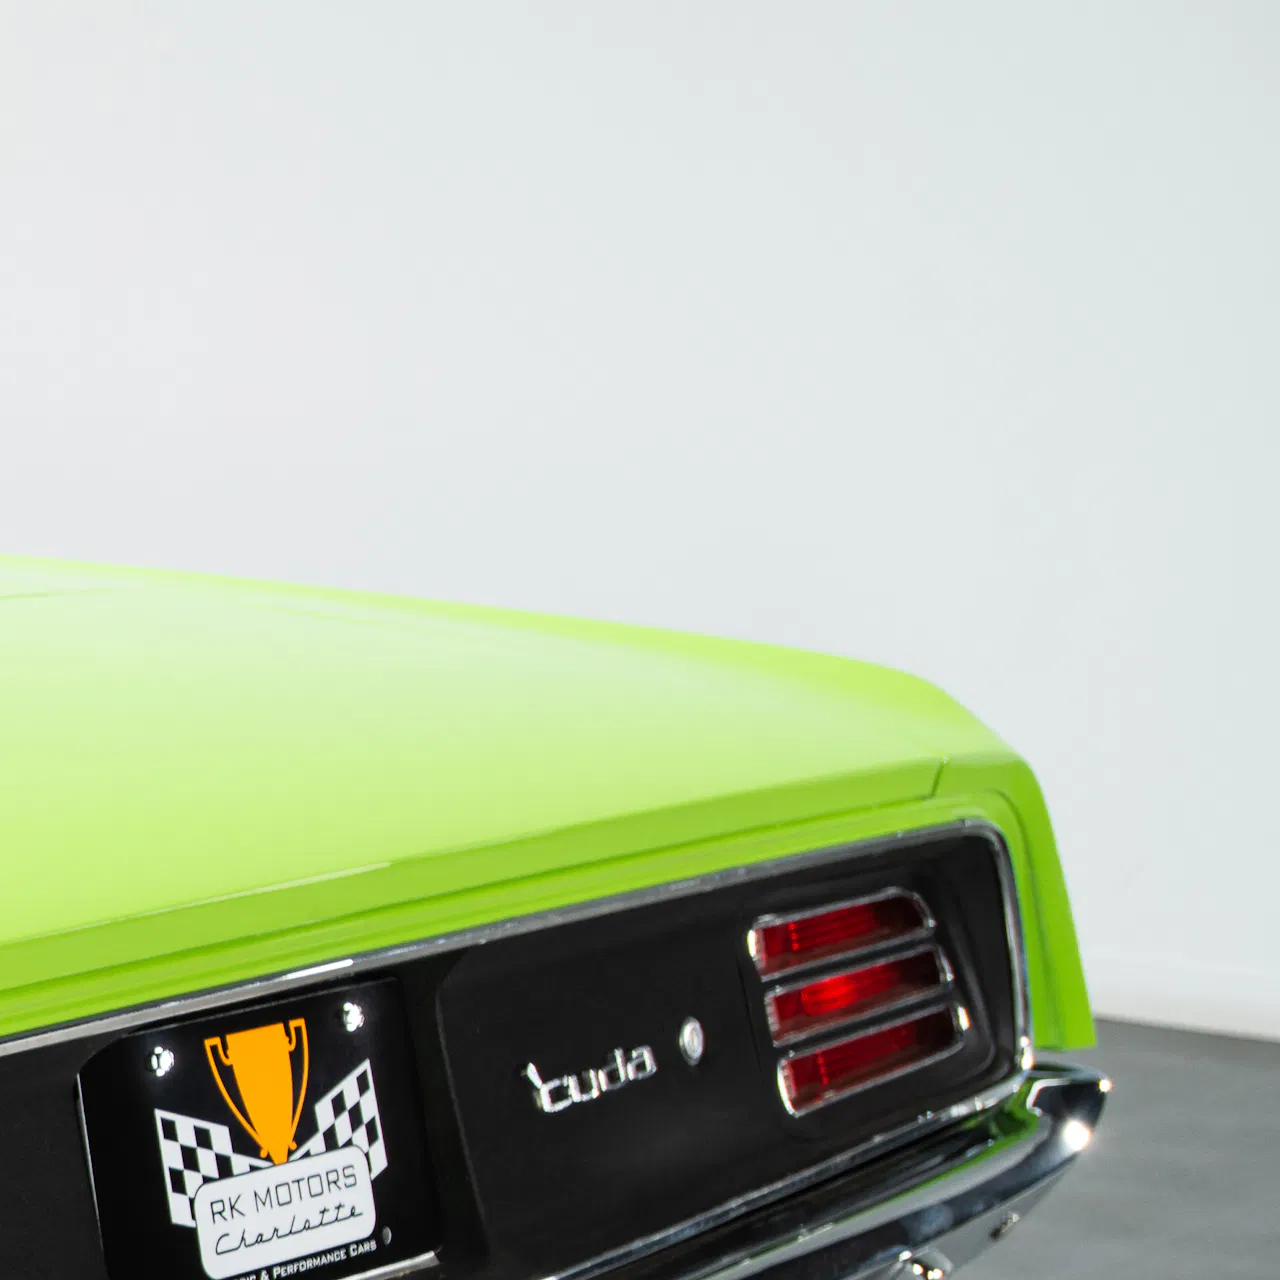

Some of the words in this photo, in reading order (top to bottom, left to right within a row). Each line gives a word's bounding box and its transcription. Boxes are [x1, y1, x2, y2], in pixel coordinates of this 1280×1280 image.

[210, 1194, 246, 1224] RK
[254, 1164, 357, 1213] MOTORS
[215, 1202, 363, 1255] Charlotte
